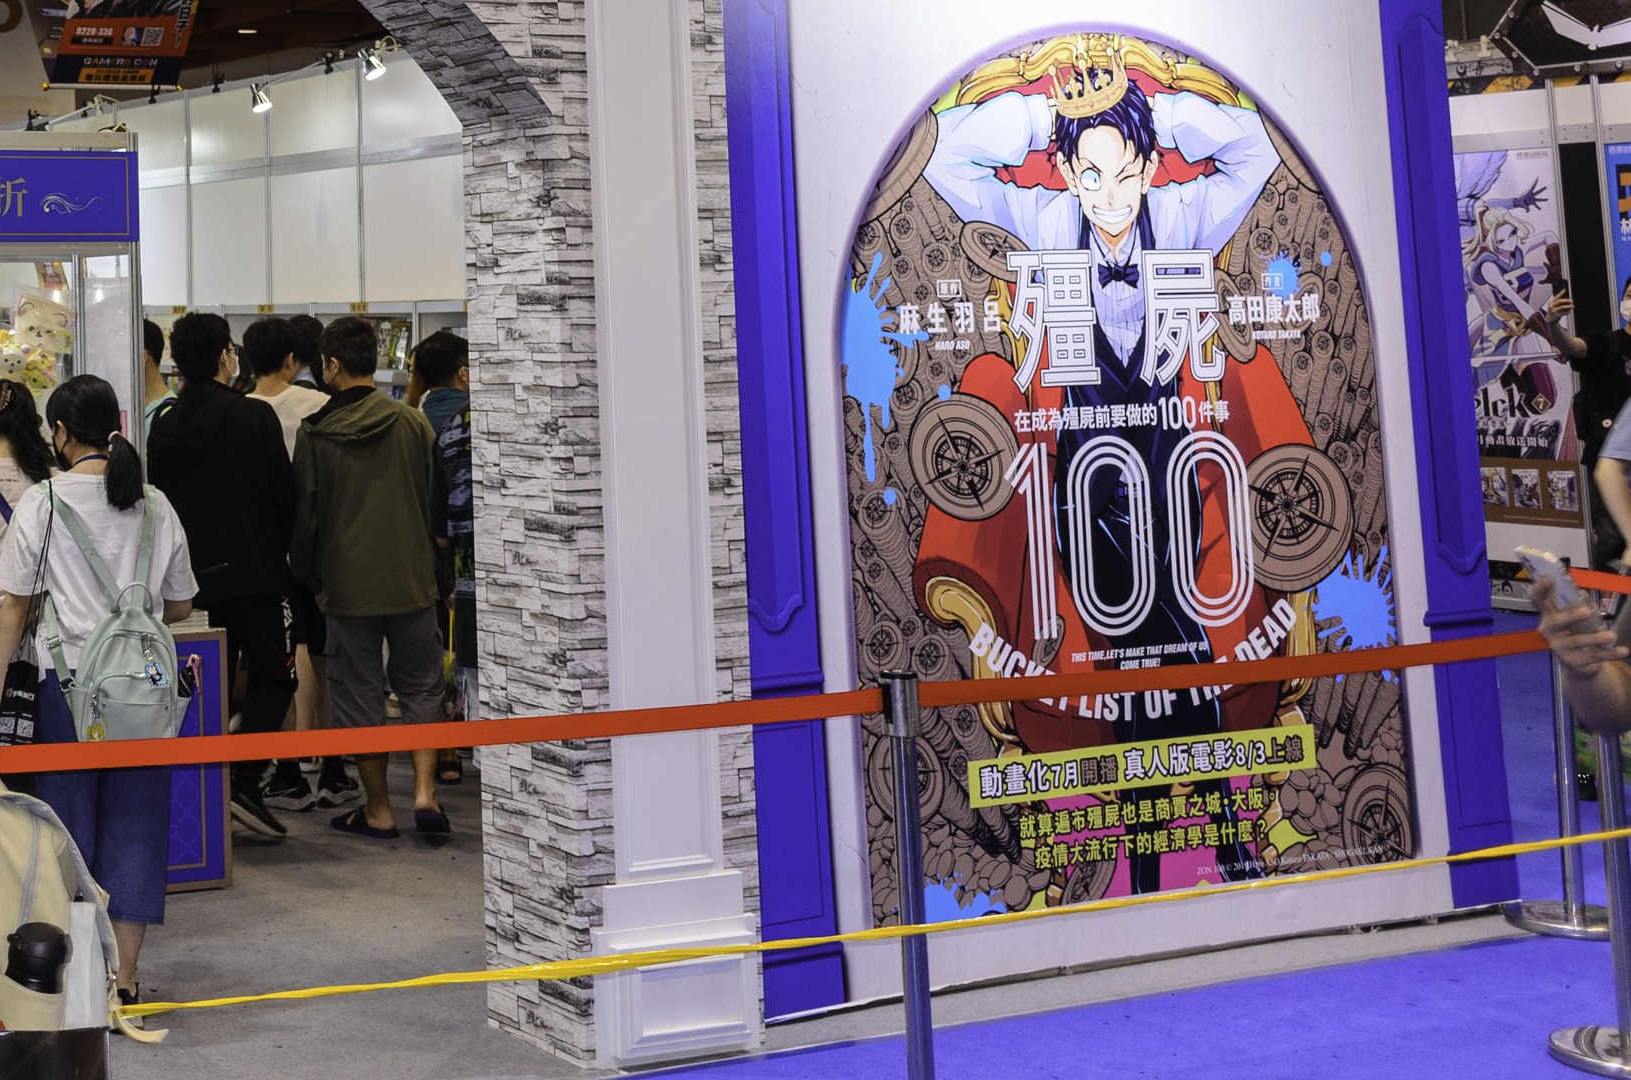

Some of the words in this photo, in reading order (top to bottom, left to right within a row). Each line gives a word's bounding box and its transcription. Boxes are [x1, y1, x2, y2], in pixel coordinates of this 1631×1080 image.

[899, 301, 1002, 335] 麻生羽呂
[1006, 247, 1228, 394] 殭屍
[1226, 292, 1321, 325] 高田康太郎
[935, 340, 953, 351] HARO
[955, 340, 970, 350] ASO
[1251, 330, 1277, 340] KOTARO
[1277, 329, 1301, 339] TAKATA
[1013, 395, 1231, 433] 在成為殭屍前要做的100件事
[1003, 430, 1255, 641] 100
[1233, 598, 1298, 662] DEAD
[1071, 652, 1087, 663] THIS
[1125, 646, 1146, 658] MAKE
[1146, 645, 1164, 656] THAT
[1164, 642, 1188, 655] DREAM
[1188, 641, 1199, 652] OF
[1199, 640, 1209, 651] US
[1120, 659, 1141, 671] COME
[1141, 657, 1162, 670] TRUE!
[1124, 734, 1304, 780] 真人版電影8/3上線
[980, 755, 1118, 799] 動畫化7月開播
[1196, 865, 1212, 876] ZON
[1302, 852, 1331, 863] TAKATA
